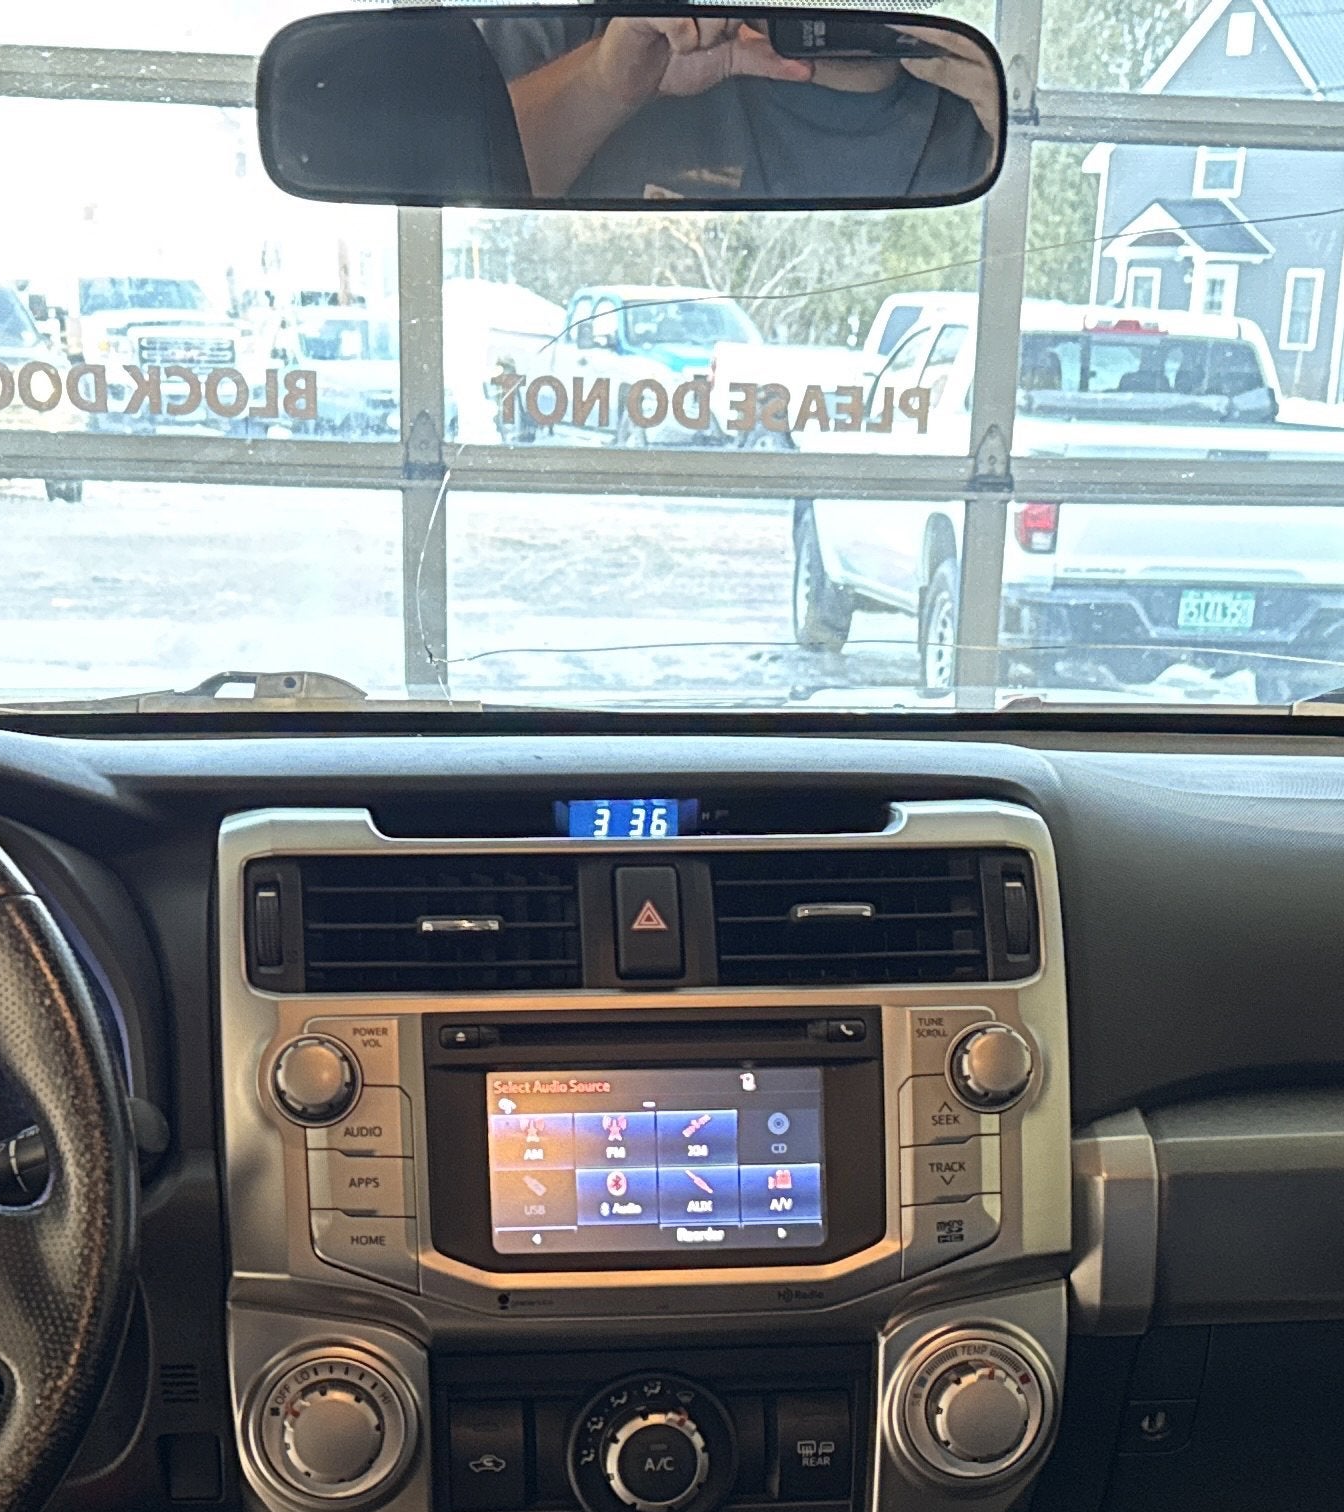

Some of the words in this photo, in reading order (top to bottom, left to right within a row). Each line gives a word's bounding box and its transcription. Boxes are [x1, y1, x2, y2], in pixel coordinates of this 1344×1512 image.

[917, 1017, 945, 1027] TUNE
[352, 1026, 389, 1037] POWER
[915, 1028, 948, 1038] SCROLL
[361, 1038, 382, 1048] VOL
[493, 1080, 531, 1095] Select
[532, 1079, 568, 1094] Audio
[568, 1079, 611, 1094] Source
[931, 1114, 961, 1125] SEEK
[343, 1126, 383, 1138] AUDIO
[771, 1142, 788, 1154] CD
[928, 1161, 967, 1174] TRACK
[348, 1177, 381, 1189] APPS
[523, 1204, 546, 1216] USB
[769, 1196, 794, 1212] A/V
[350, 1235, 386, 1246] HOME
[961, 1345, 988, 1356] TEMP
[294, 1371, 311, 1385] LO
[274, 1384, 291, 1405] OFF
[644, 1456, 675, 1472] A/C
[802, 1455, 831, 1467] REAR
